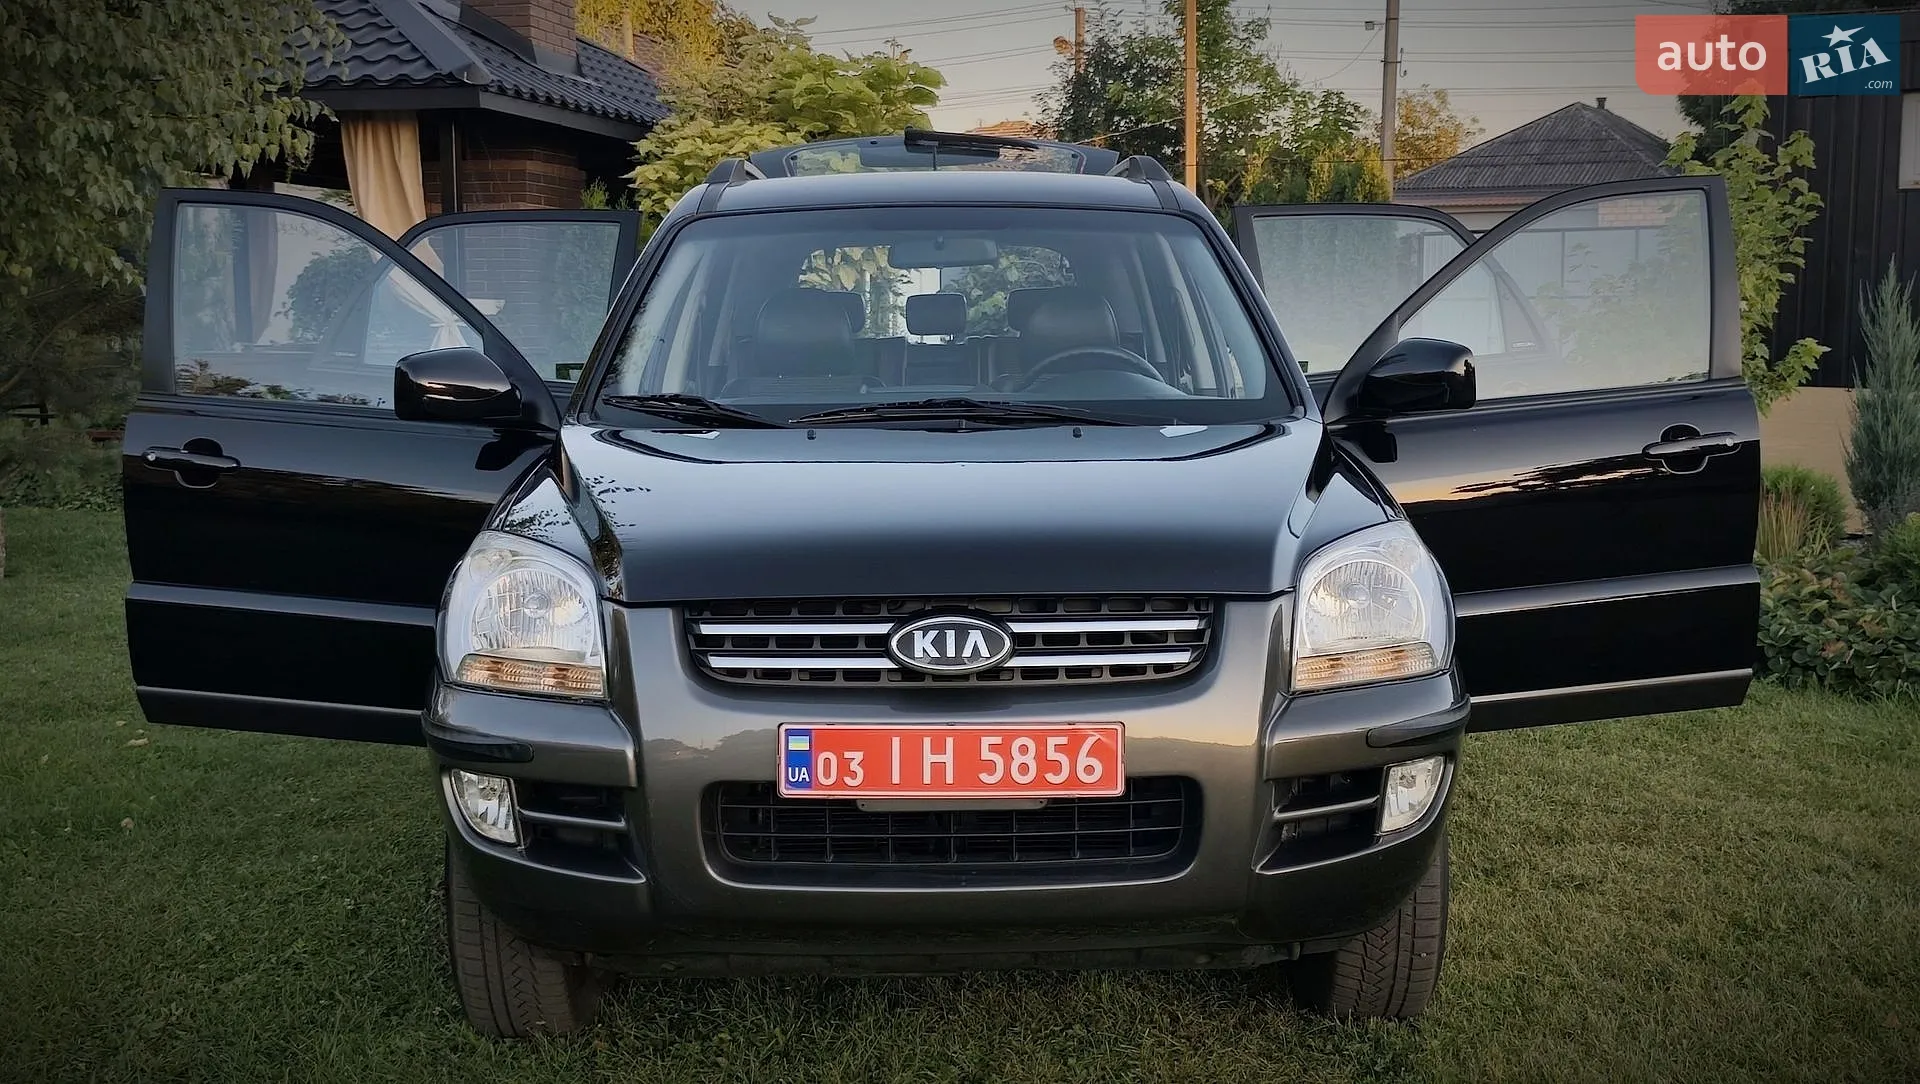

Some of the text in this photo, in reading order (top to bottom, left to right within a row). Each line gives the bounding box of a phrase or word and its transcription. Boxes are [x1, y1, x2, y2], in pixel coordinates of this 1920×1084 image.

[912, 629, 991, 658] KIA
[788, 766, 810, 782] UA
[816, 751, 865, 787] 03
[977, 736, 1104, 785] 5856
